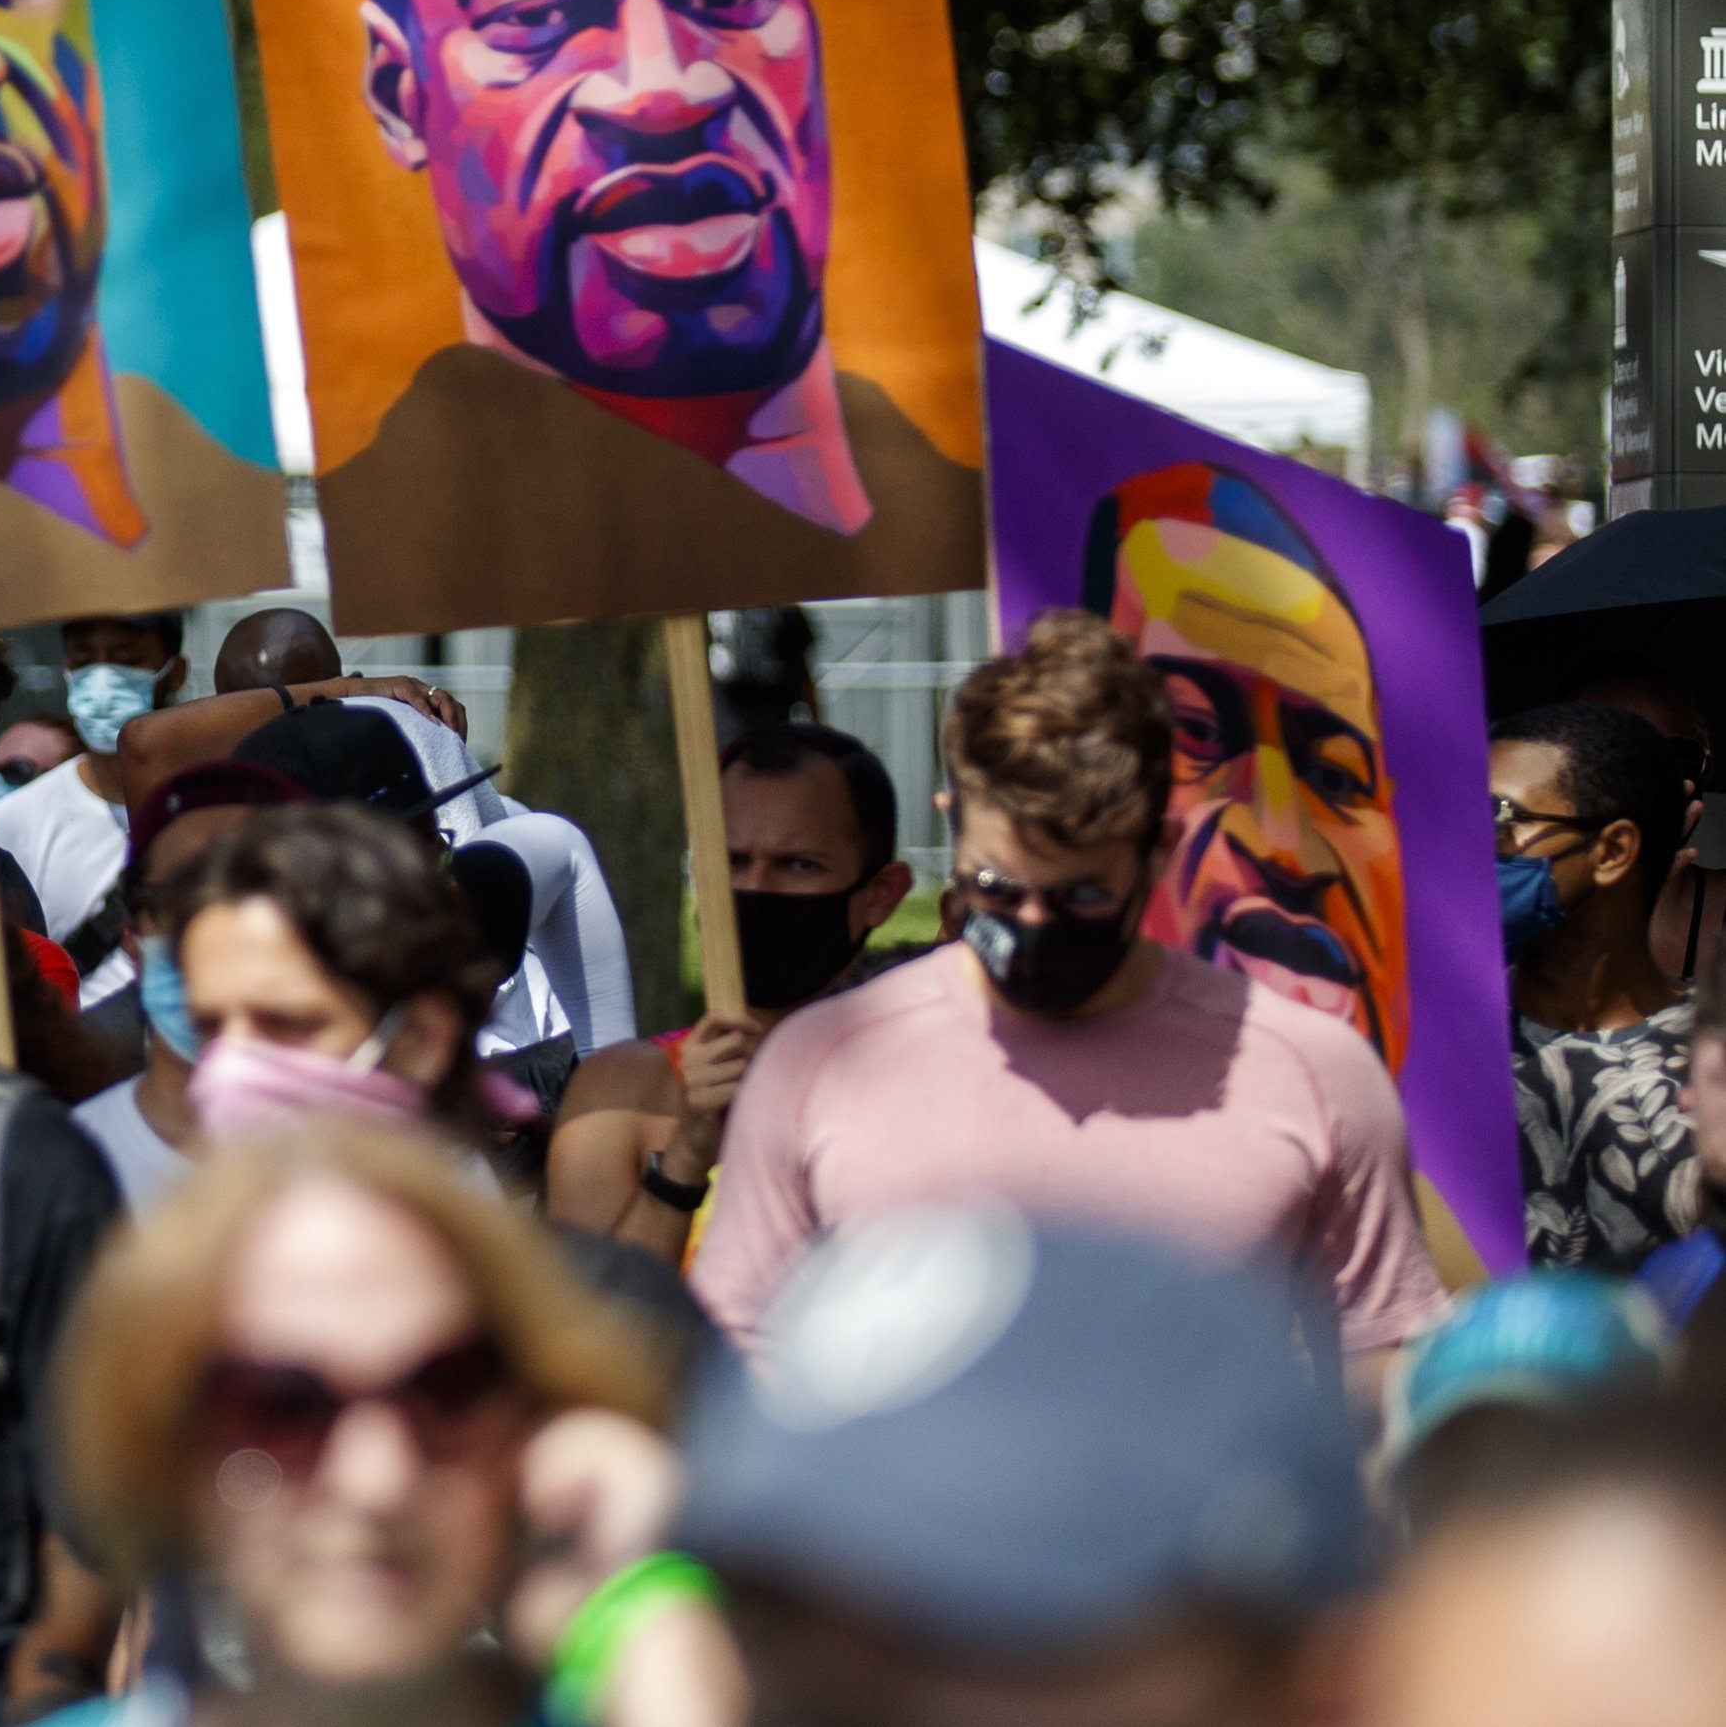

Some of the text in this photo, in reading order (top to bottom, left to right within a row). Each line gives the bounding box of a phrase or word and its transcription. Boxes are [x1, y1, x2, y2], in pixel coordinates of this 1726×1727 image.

[1696, 139, 1726, 167] M
[1694, 349, 1726, 377] Vi
[1696, 422, 1726, 450] M
